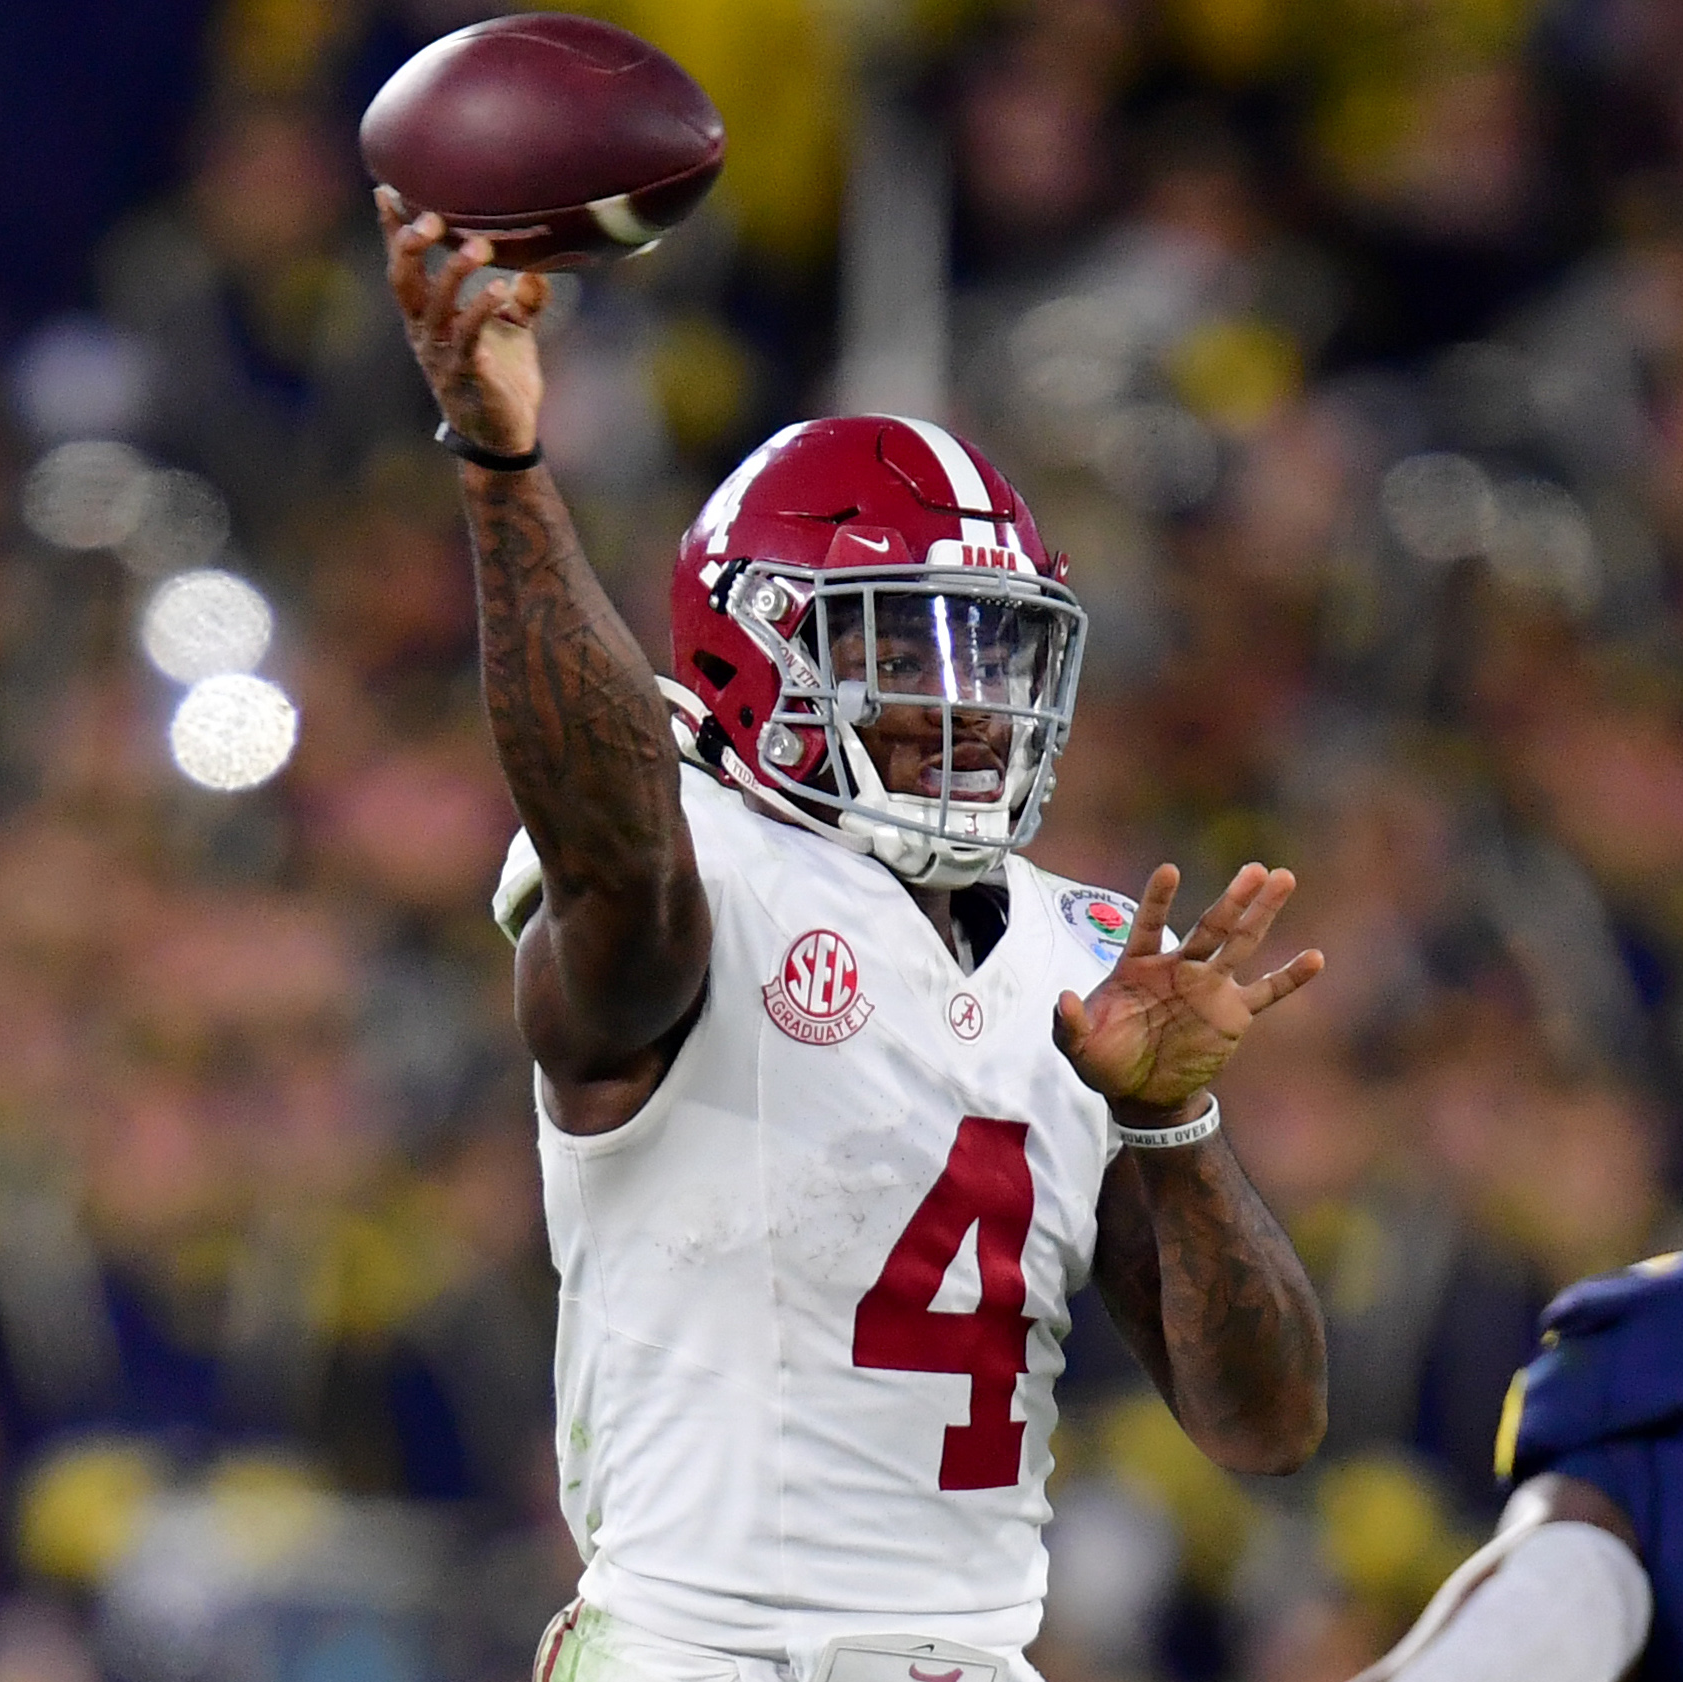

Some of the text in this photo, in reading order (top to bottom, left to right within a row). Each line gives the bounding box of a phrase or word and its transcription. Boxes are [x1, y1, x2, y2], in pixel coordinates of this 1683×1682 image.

[962, 545, 1017, 571] BAMA
[787, 932, 856, 1015] SEC
[771, 1002, 859, 1042] GRADUATE
[953, 1000, 977, 1030] A
[1175, 1123, 1208, 1142] OVER
[852, 1114, 1038, 1491] 4
